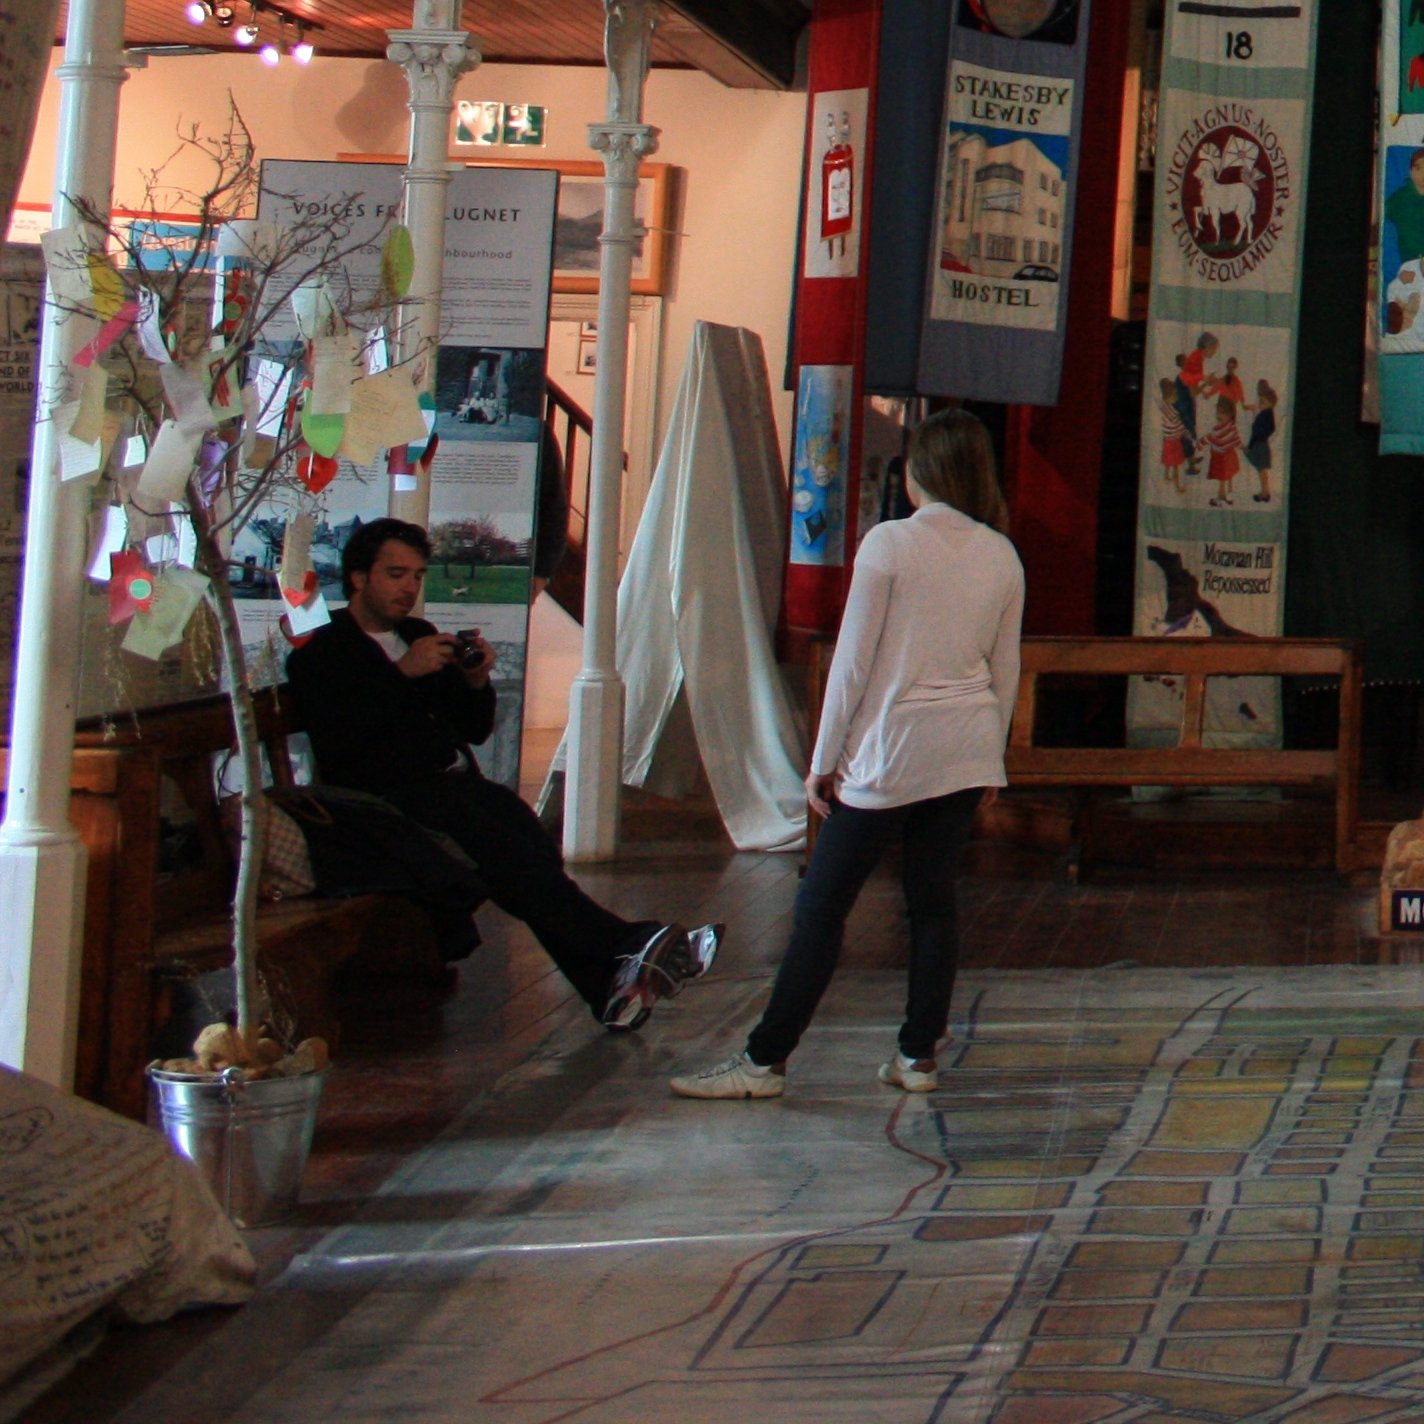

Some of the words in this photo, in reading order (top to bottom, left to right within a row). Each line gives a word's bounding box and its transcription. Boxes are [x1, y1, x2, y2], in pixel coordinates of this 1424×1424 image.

[1226, 31, 1253, 60] 18
[954, 75, 1070, 106] STAKESBY
[971, 98, 1041, 126] LEWIS
[293, 203, 365, 217] VOICES
[951, 280, 1040, 308] HOSTEL
[1202, 543, 1251, 569] Moravian
[1254, 546, 1274, 568] Hill
[1202, 571, 1271, 599] Repossessed
